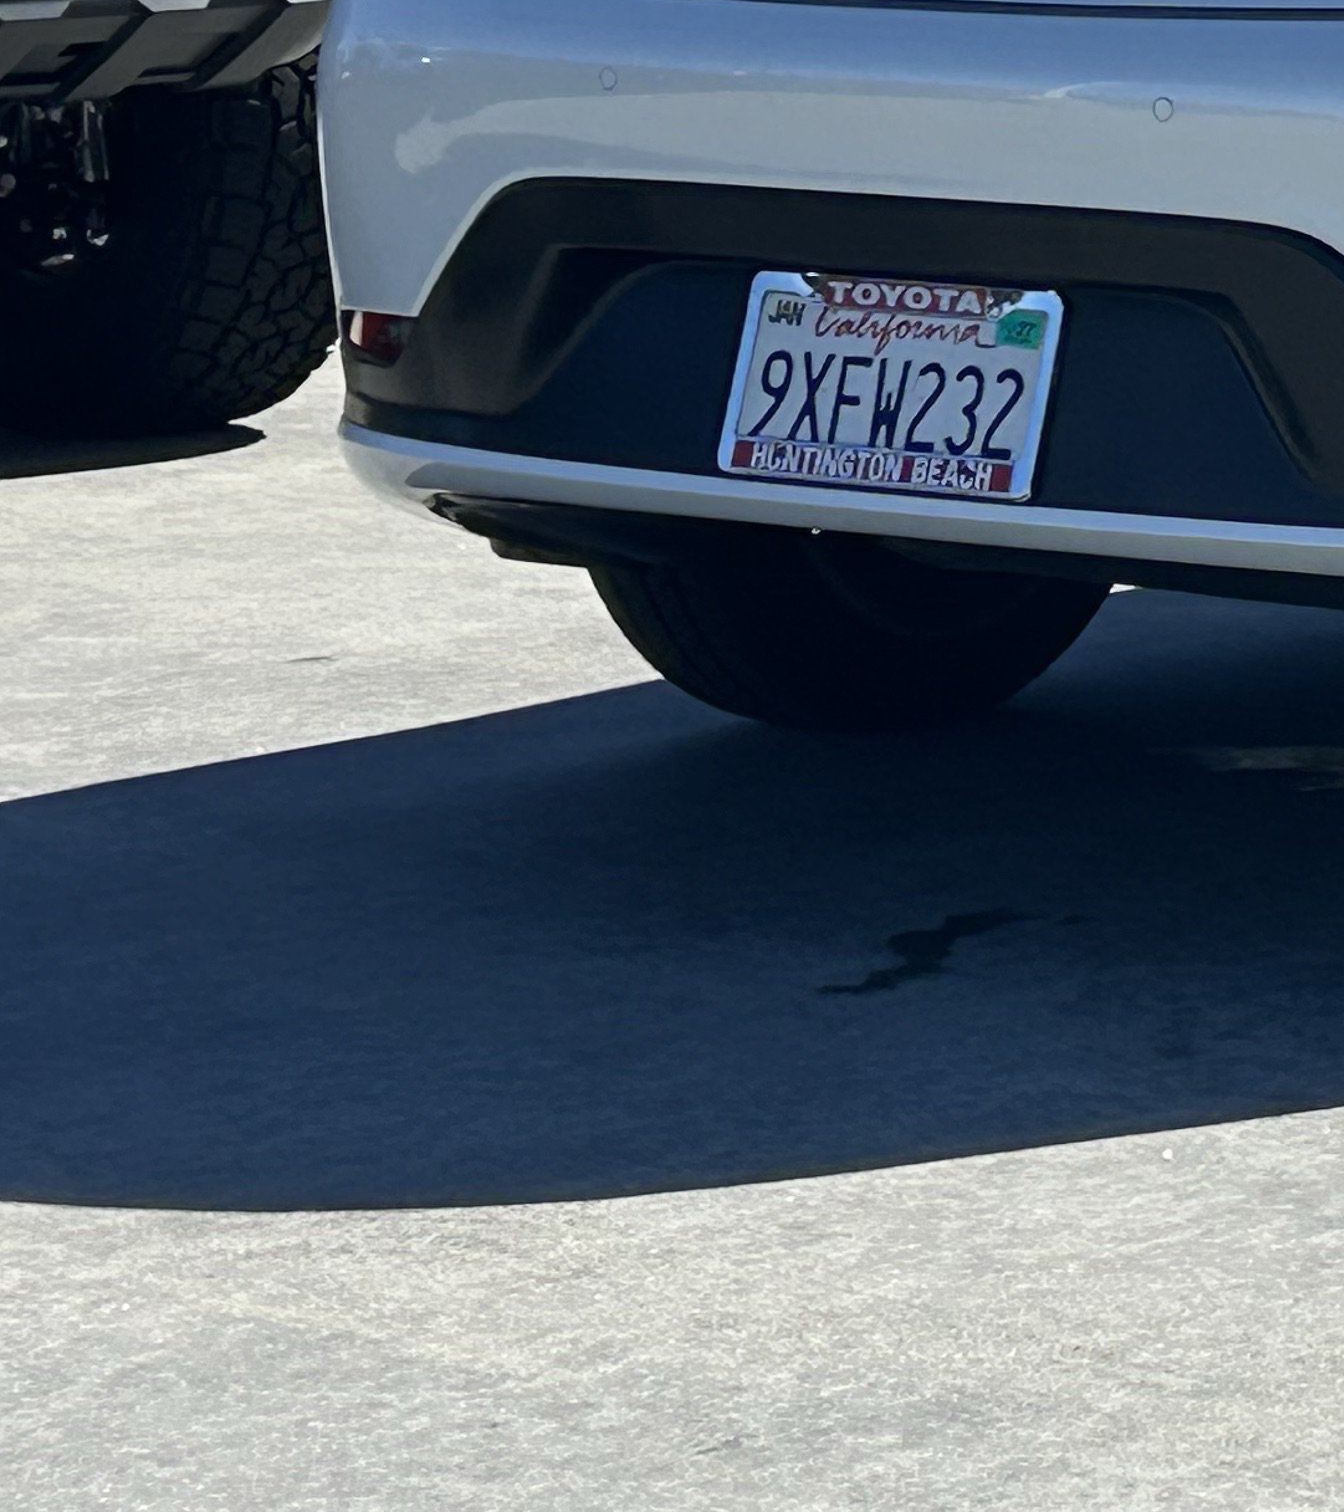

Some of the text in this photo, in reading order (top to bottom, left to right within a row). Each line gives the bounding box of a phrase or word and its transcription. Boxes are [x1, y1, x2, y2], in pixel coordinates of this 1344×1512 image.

[827, 280, 982, 315] TOYOTA
[814, 306, 997, 355] California
[748, 349, 1025, 460] 9XFW232
[910, 456, 994, 492] BEACH
